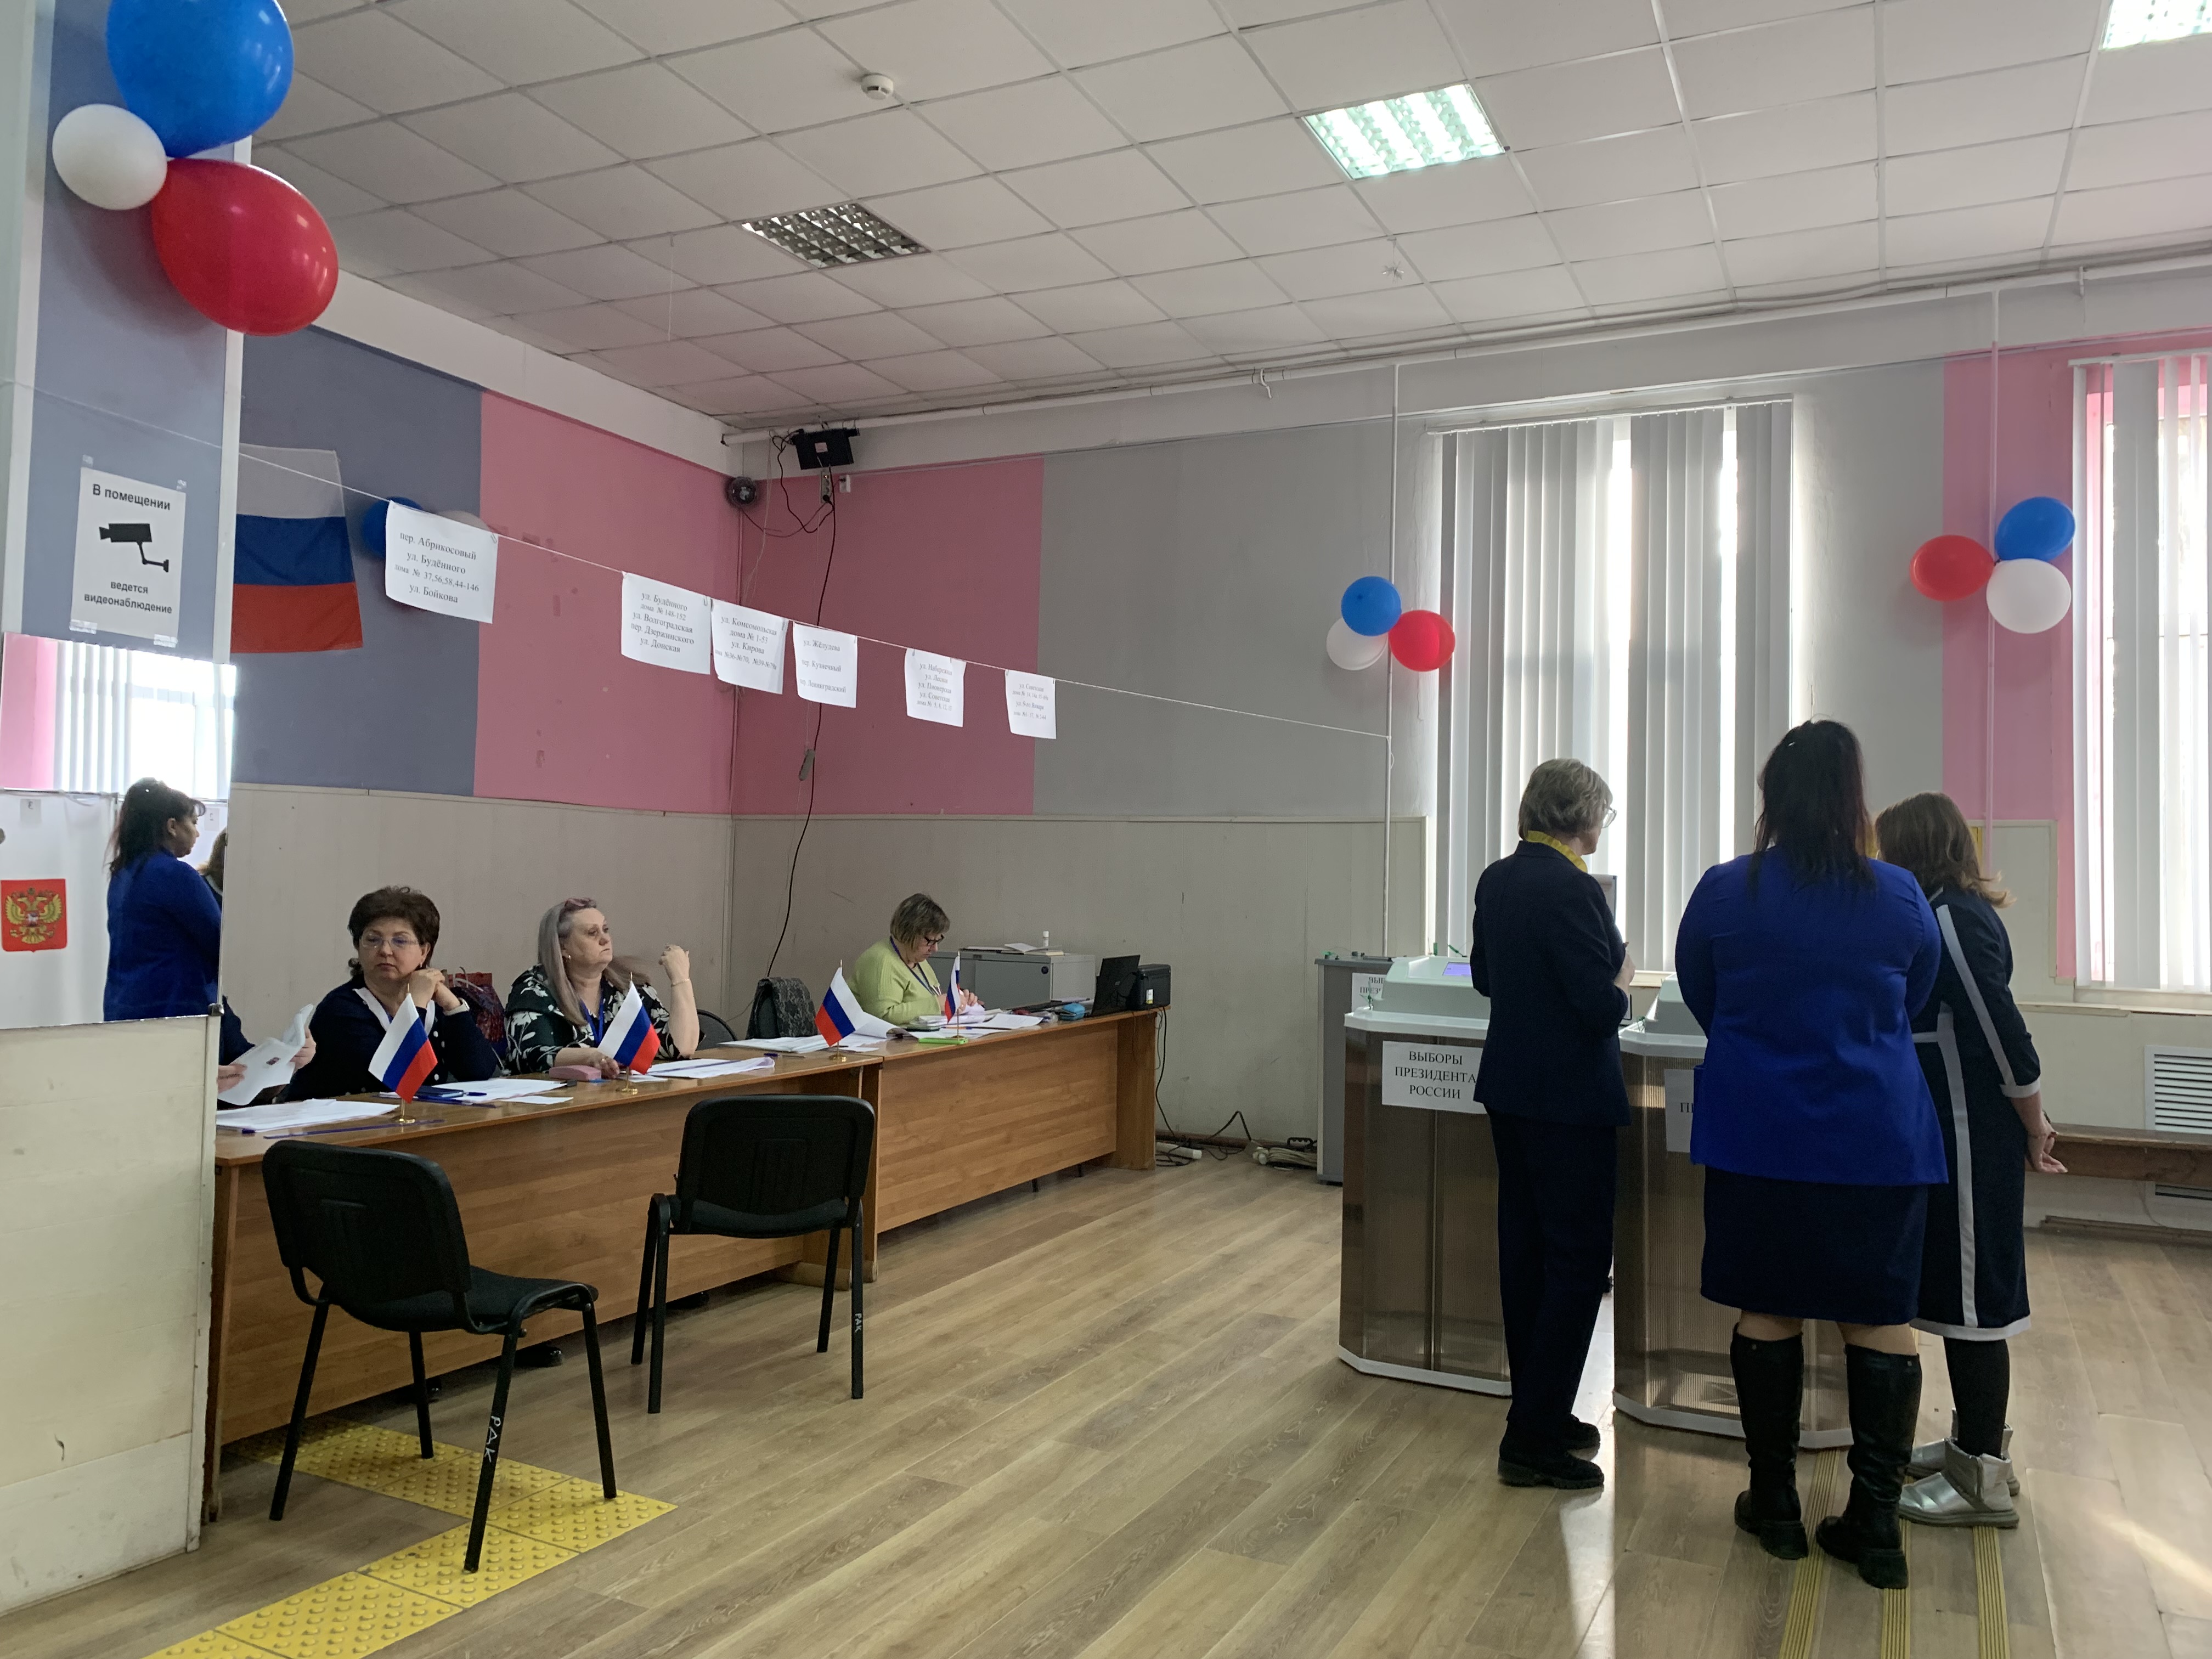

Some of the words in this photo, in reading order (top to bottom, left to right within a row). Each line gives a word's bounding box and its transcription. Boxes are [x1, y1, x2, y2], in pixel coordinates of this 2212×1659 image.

[93, 483, 100, 495] В
[105, 489, 171, 510] помещении
[400, 532, 415, 544] пер.
[418, 537, 476, 560] Абрикосовый
[407, 552, 419, 561] ул.
[421, 554, 466, 574] Будённого
[394, 564, 409, 574] дома
[412, 568, 420, 577] №
[111, 582, 148, 594] ведется
[409, 584, 421, 593] ул.
[424, 586, 458, 603] Бойкова
[84, 594, 172, 614] видеонаблюдение
[641, 592, 651, 601] ул.
[653, 594, 687, 611] Будённого
[640, 603, 654, 612] дома
[665, 609, 686, 621] 148-152
[644, 613, 693, 633] Волгоградская
[732, 618, 777, 635] Комсомольская
[631, 623, 643, 633] пер.
[645, 625, 694, 645] Дзержинского
[730, 630, 746, 639] дома
[747, 632, 754, 641] №
[757, 635, 768, 644] 1-53
[651, 639, 681, 652] Донская
[742, 642, 765, 654] Кирова
[812, 661, 842, 672] Кузнечный
[808, 680, 846, 693] Ленинградский
[927, 682, 952, 693] Пионерская
[1026, 684, 1044, 692] Советская
[928, 692, 950, 702] Советская
[1409, 1051, 1463, 1065] ВЫБОРЫ
[1395, 1066, 1476, 1083] ПРЕЗИДЕНТА
[1409, 1085, 1460, 1099] РОССИИ
